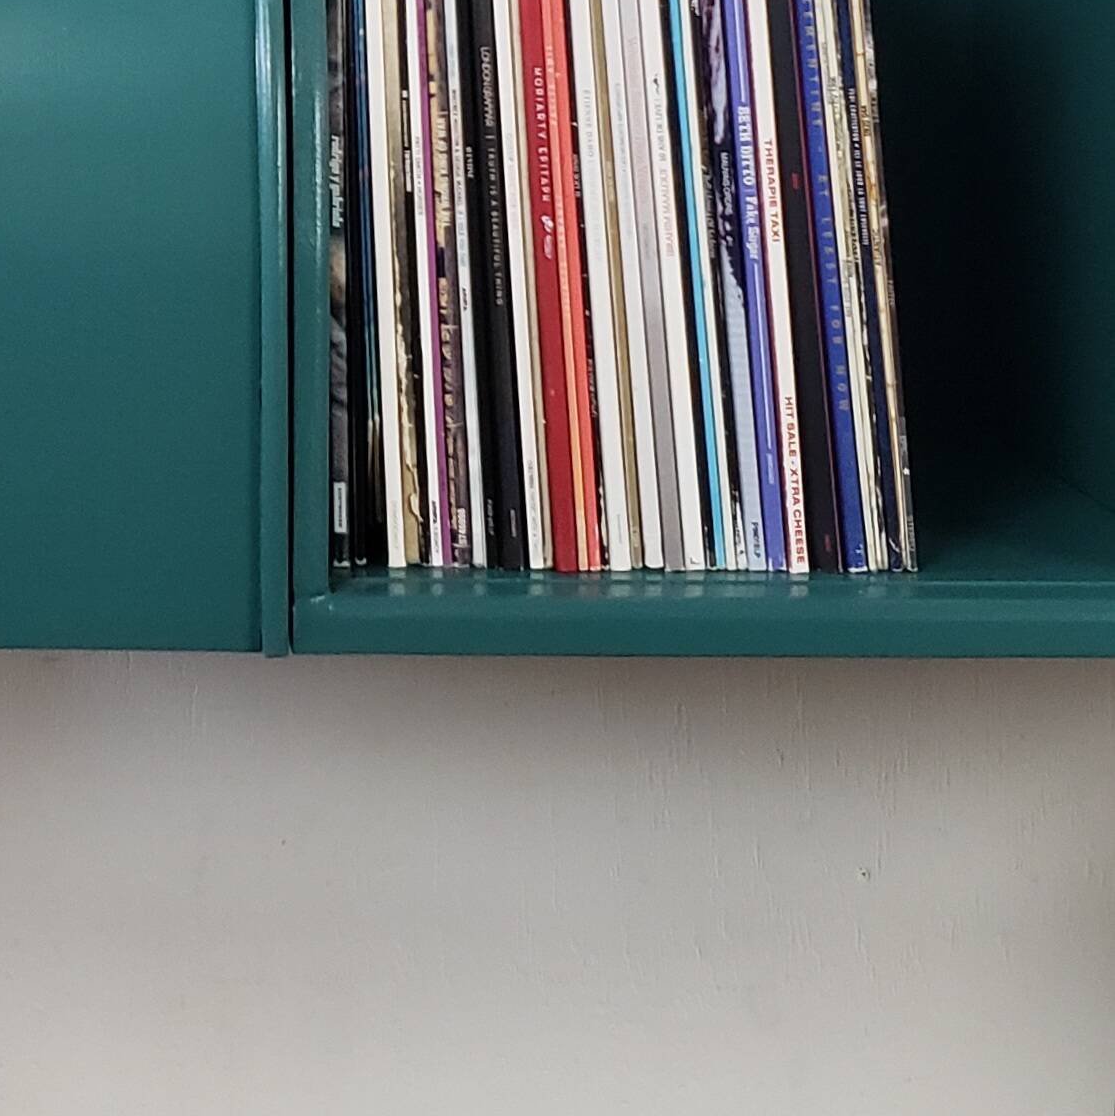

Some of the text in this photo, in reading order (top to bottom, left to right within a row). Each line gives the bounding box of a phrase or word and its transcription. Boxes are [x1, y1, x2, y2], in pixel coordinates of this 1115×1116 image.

[534, 67, 551, 202] MORIARTY EPITAPH
[738, 106, 750, 142] BETH
[740, 145, 753, 186] DITTO
[764, 139, 780, 242] THERAPIE TAXI
[784, 396, 796, 419] HIT
[786, 422, 797, 458] SALE
[789, 468, 800, 506] XTRA
[794, 508, 805, 564] CHEESE
